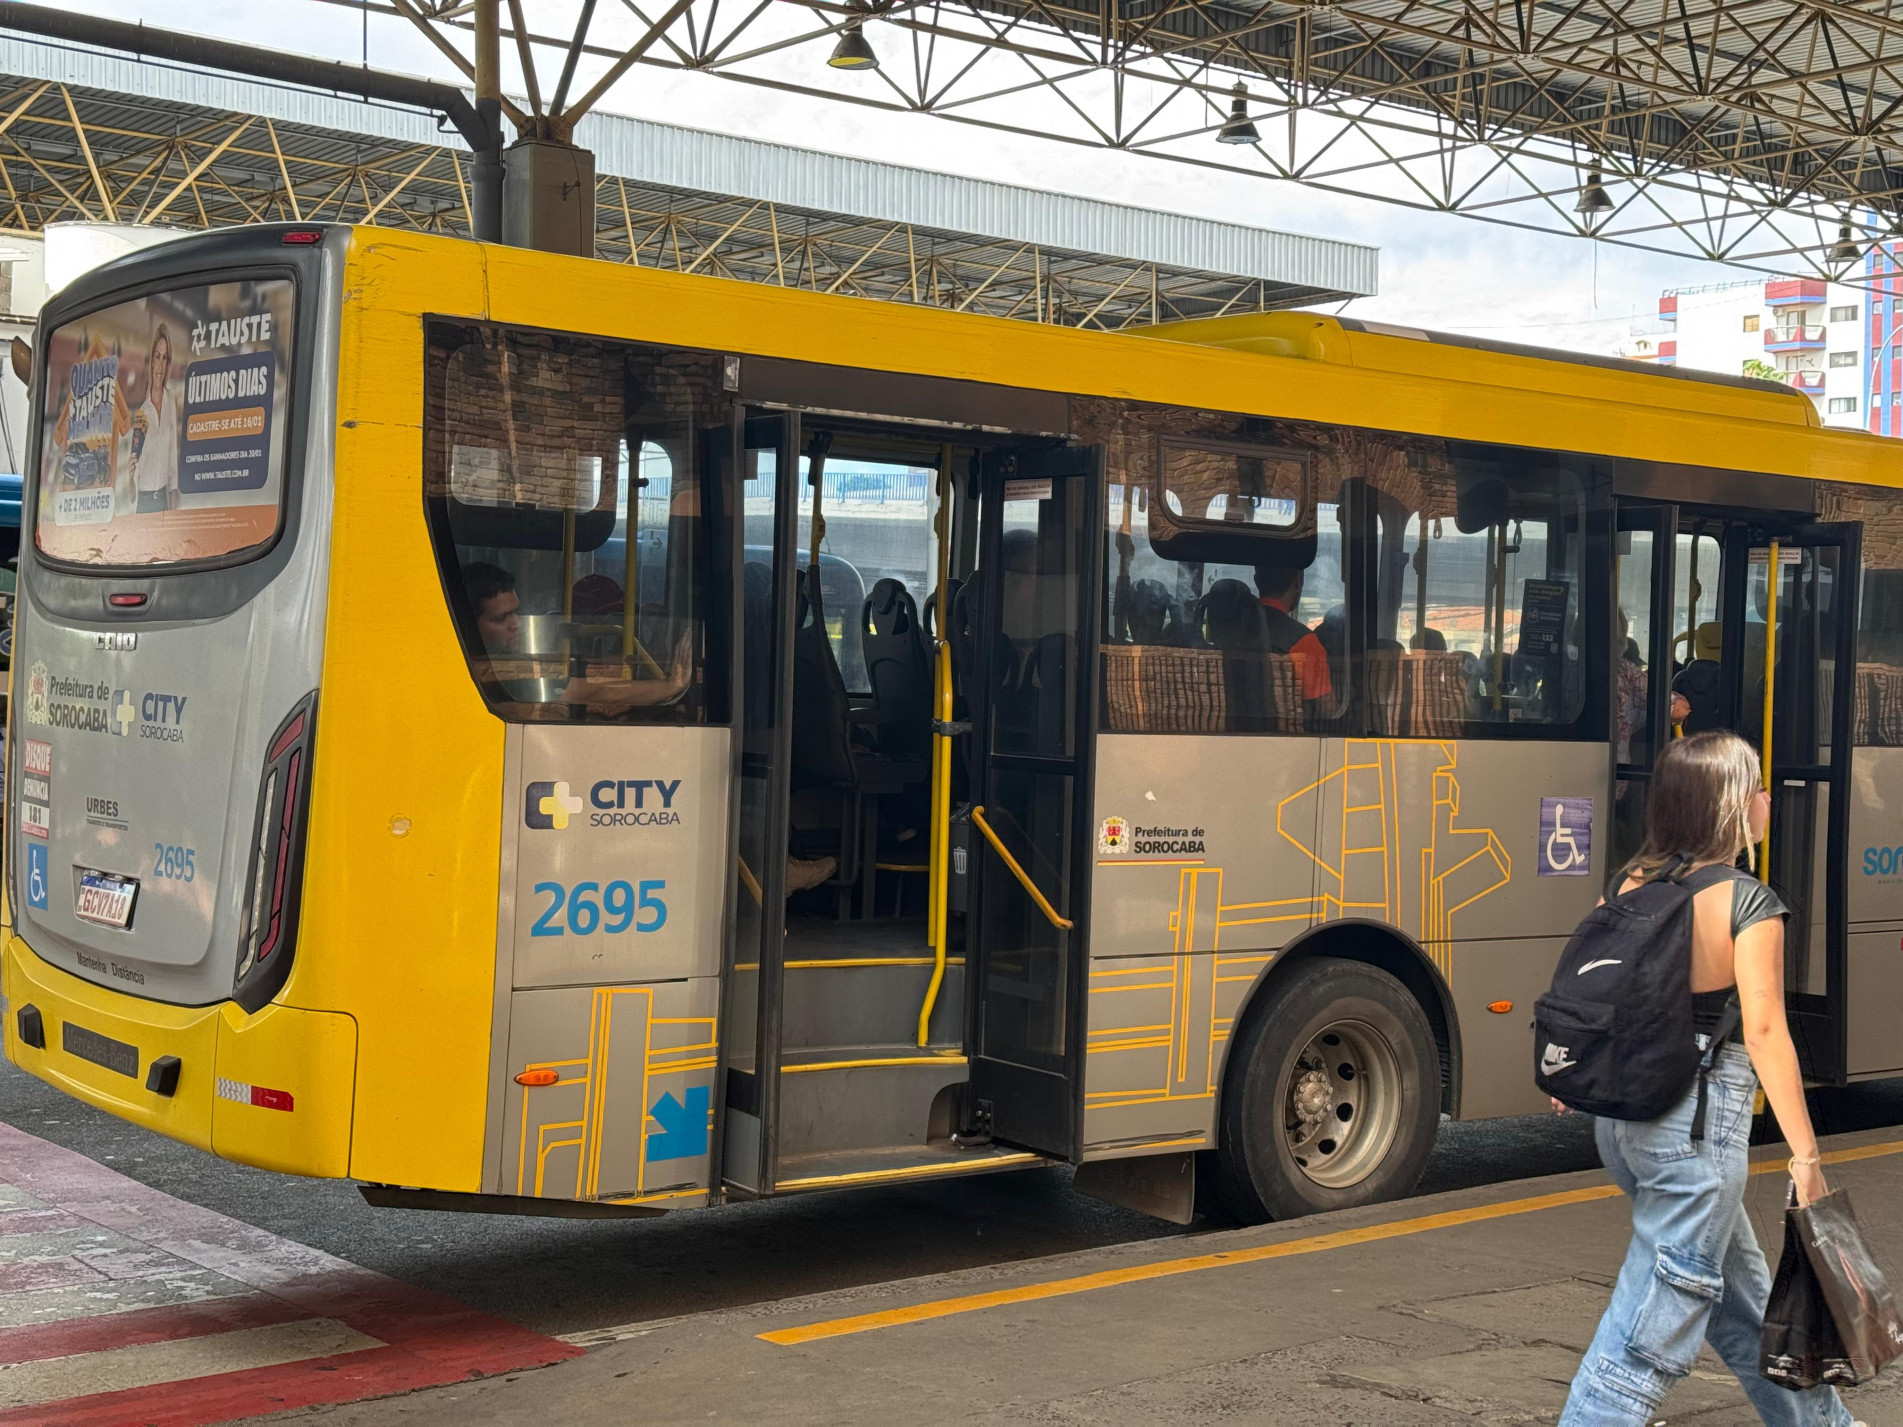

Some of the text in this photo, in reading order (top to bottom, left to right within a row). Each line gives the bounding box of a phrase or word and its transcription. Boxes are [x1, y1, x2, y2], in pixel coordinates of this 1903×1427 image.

[209, 313, 272, 348] TAUSTE
[187, 365, 268, 404] ÚLTIMOS DIAS
[188, 414, 262, 434] CADASTRE-SE ATÉ 16/01
[63, 498, 73, 513] DE
[73, 497, 78, 512] 2
[50, 675, 110, 701] Prefeitura de
[48, 702, 109, 733] SOROCABA
[141, 692, 188, 725] CITY
[140, 724, 184, 743] SOROCABA
[25, 742, 51, 772] DISQUE
[86, 796, 119, 817] URBES
[590, 779, 682, 810] CITY
[29, 804, 41, 824] 181
[590, 812, 681, 827] SOROCABA
[1134, 826, 1205, 838] Prefeitura de
[1133, 840, 1206, 854] SOROCABA
[1862, 846, 1903, 876] sor
[153, 843, 195, 883] 2695
[531, 879, 668, 937] 2695
[76, 951, 107, 974] Mantenha
[65, 1025, 135, 1074] Mercedes-Benz
